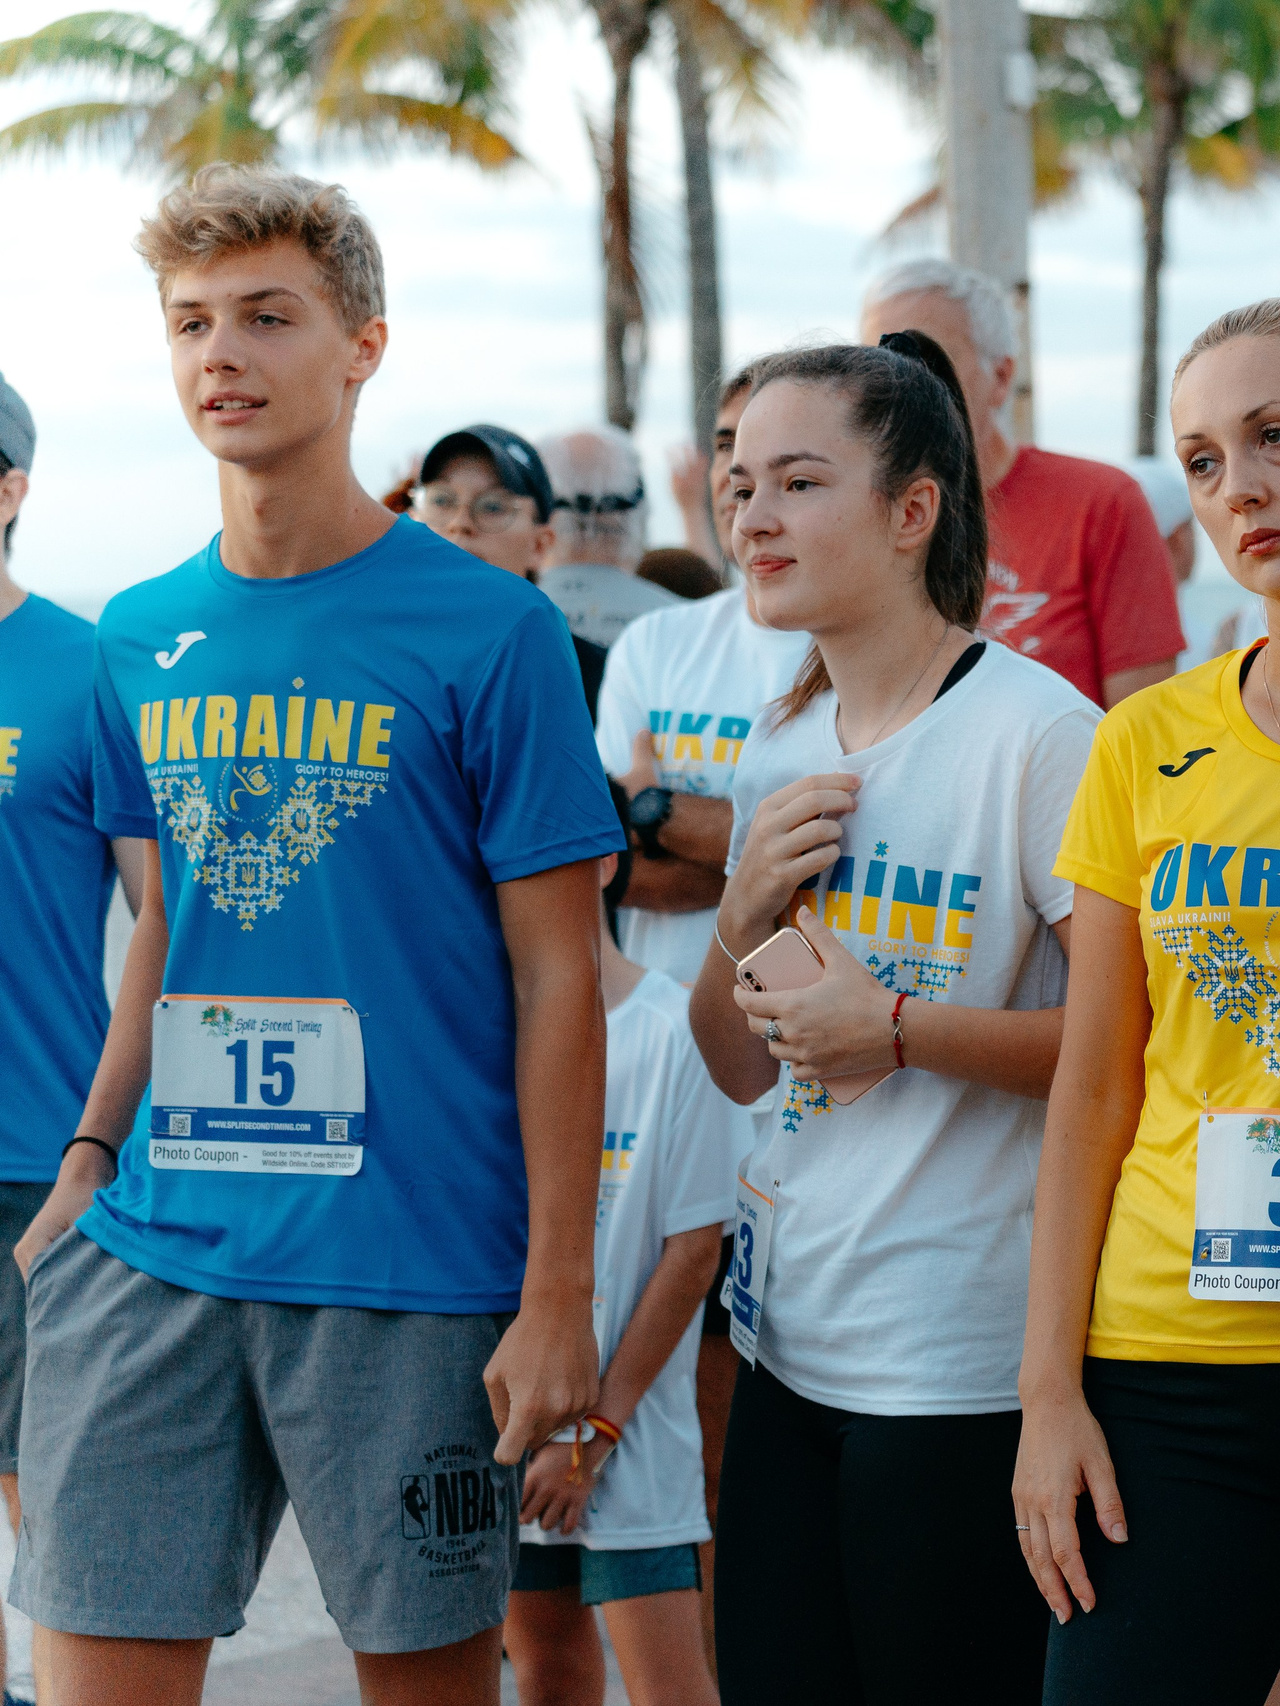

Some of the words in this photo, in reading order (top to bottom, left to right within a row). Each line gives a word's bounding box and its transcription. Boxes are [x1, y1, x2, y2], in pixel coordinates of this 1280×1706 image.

[140, 695, 396, 768] UKRAINE
[295, 764, 327, 776] GLORY
[330, 767, 344, 777] TO
[346, 769, 389, 782] HEROES!
[1177, 911, 1231, 924] UKRAINI!
[868, 939, 907, 955] GLORY
[911, 946, 928, 958] TO
[235, 1018, 257, 1034] Split
[296, 1019, 322, 1039] Timing
[226, 1039, 295, 1107] 15
[207, 1120, 311, 1132] WWW.SPLITSECONDTIMING.COM
[154, 1146, 191, 1161] Photo
[194, 1147, 239, 1163] Coupon
[1194, 1274, 1231, 1290] Photo
[424, 1444, 478, 1464] NATIONAL
[443, 1460, 458, 1469] EST
[434, 1467, 496, 1538] NBA
